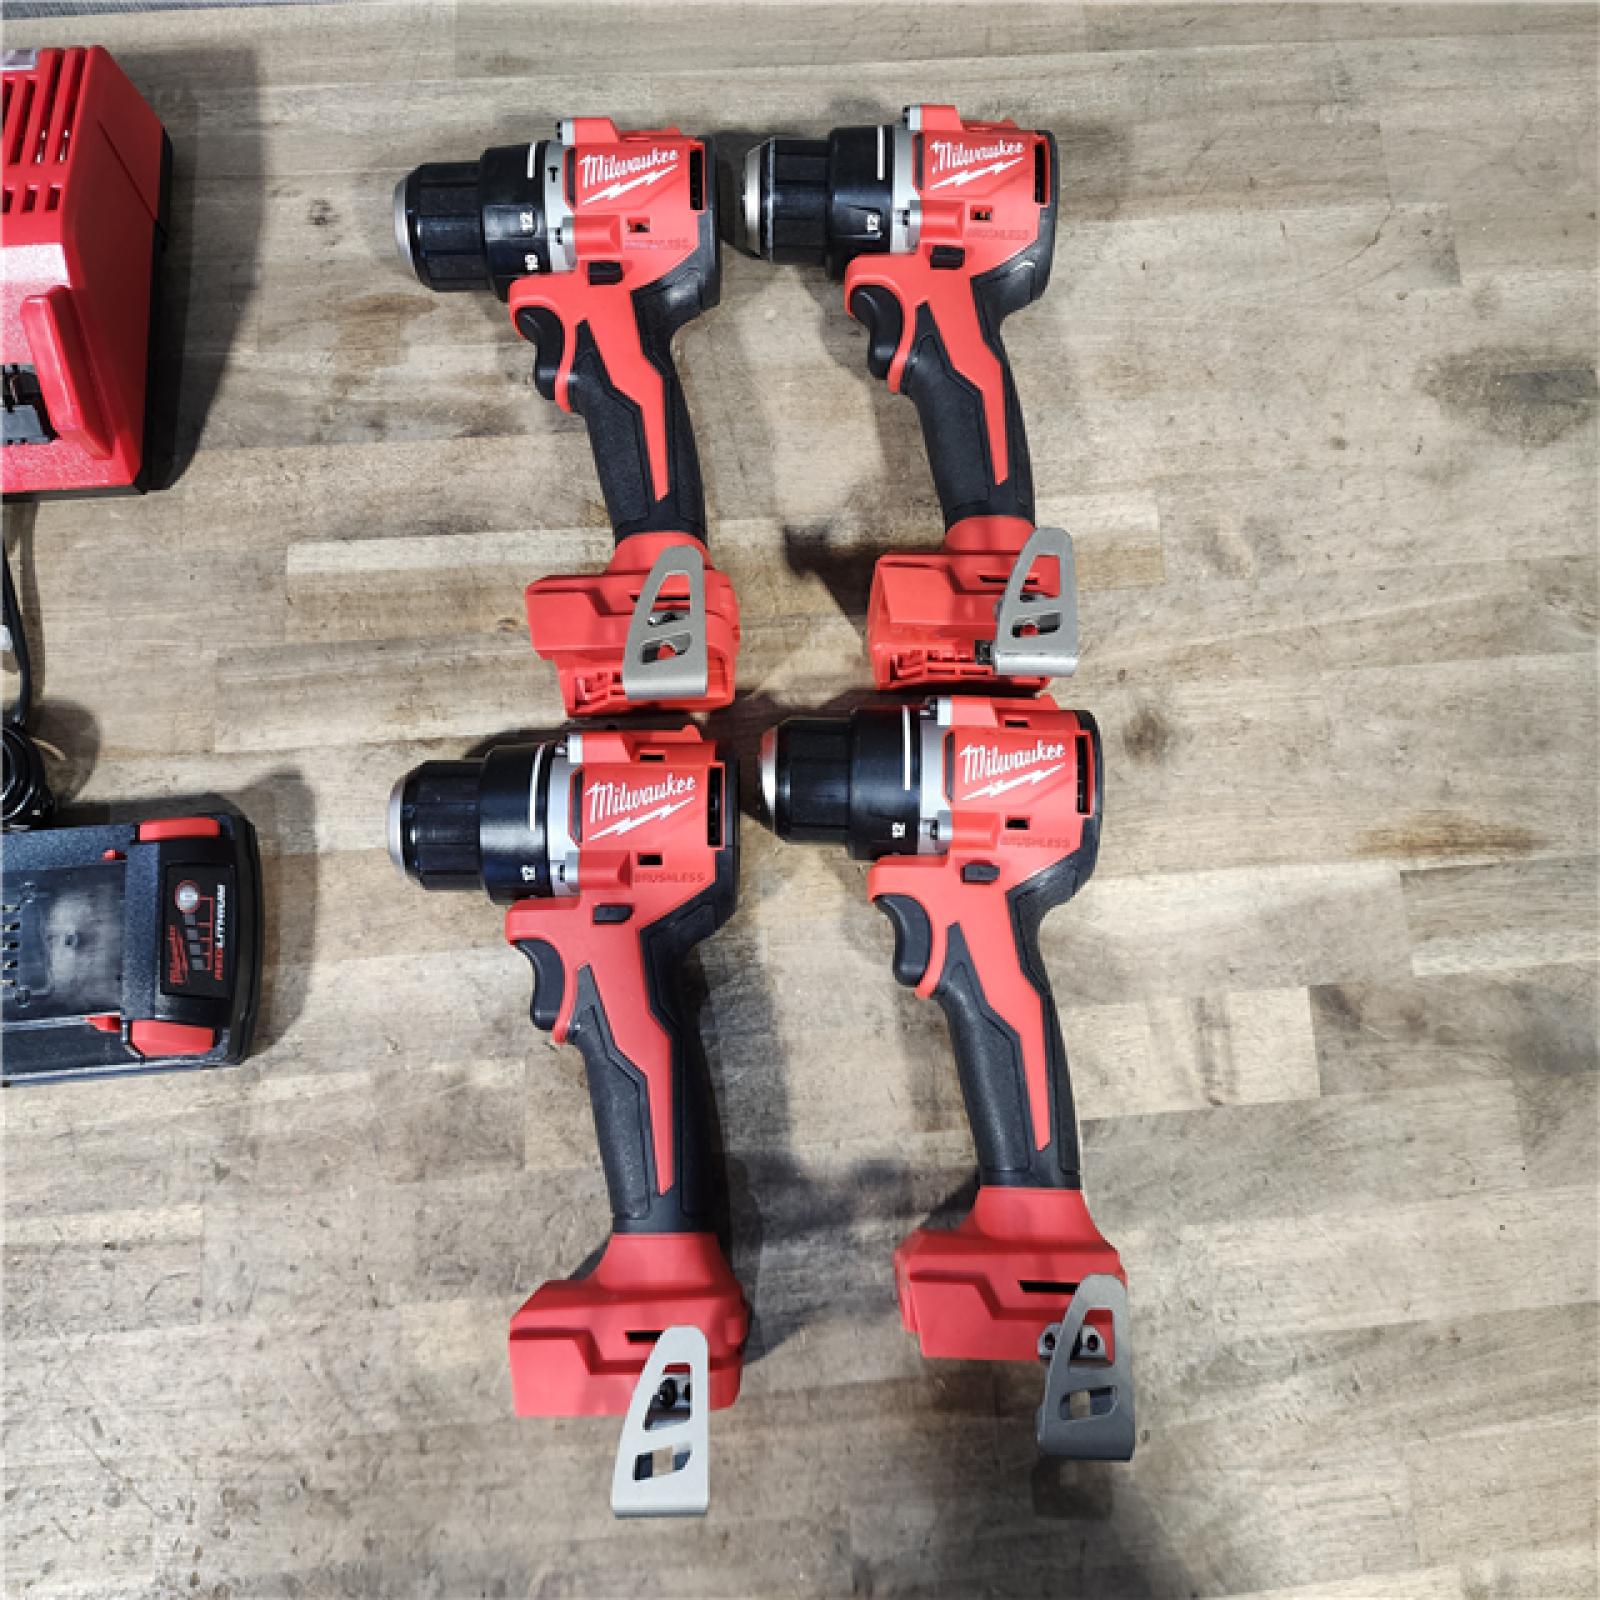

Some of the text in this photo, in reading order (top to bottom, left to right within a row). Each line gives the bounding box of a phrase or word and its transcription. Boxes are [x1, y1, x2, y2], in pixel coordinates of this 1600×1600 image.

[579, 147, 679, 189] Milwaukee
[929, 139, 1025, 175] Milwaukee
[959, 739, 1066, 785] Milwaukee
[585, 772, 696, 824] Milwaukee
